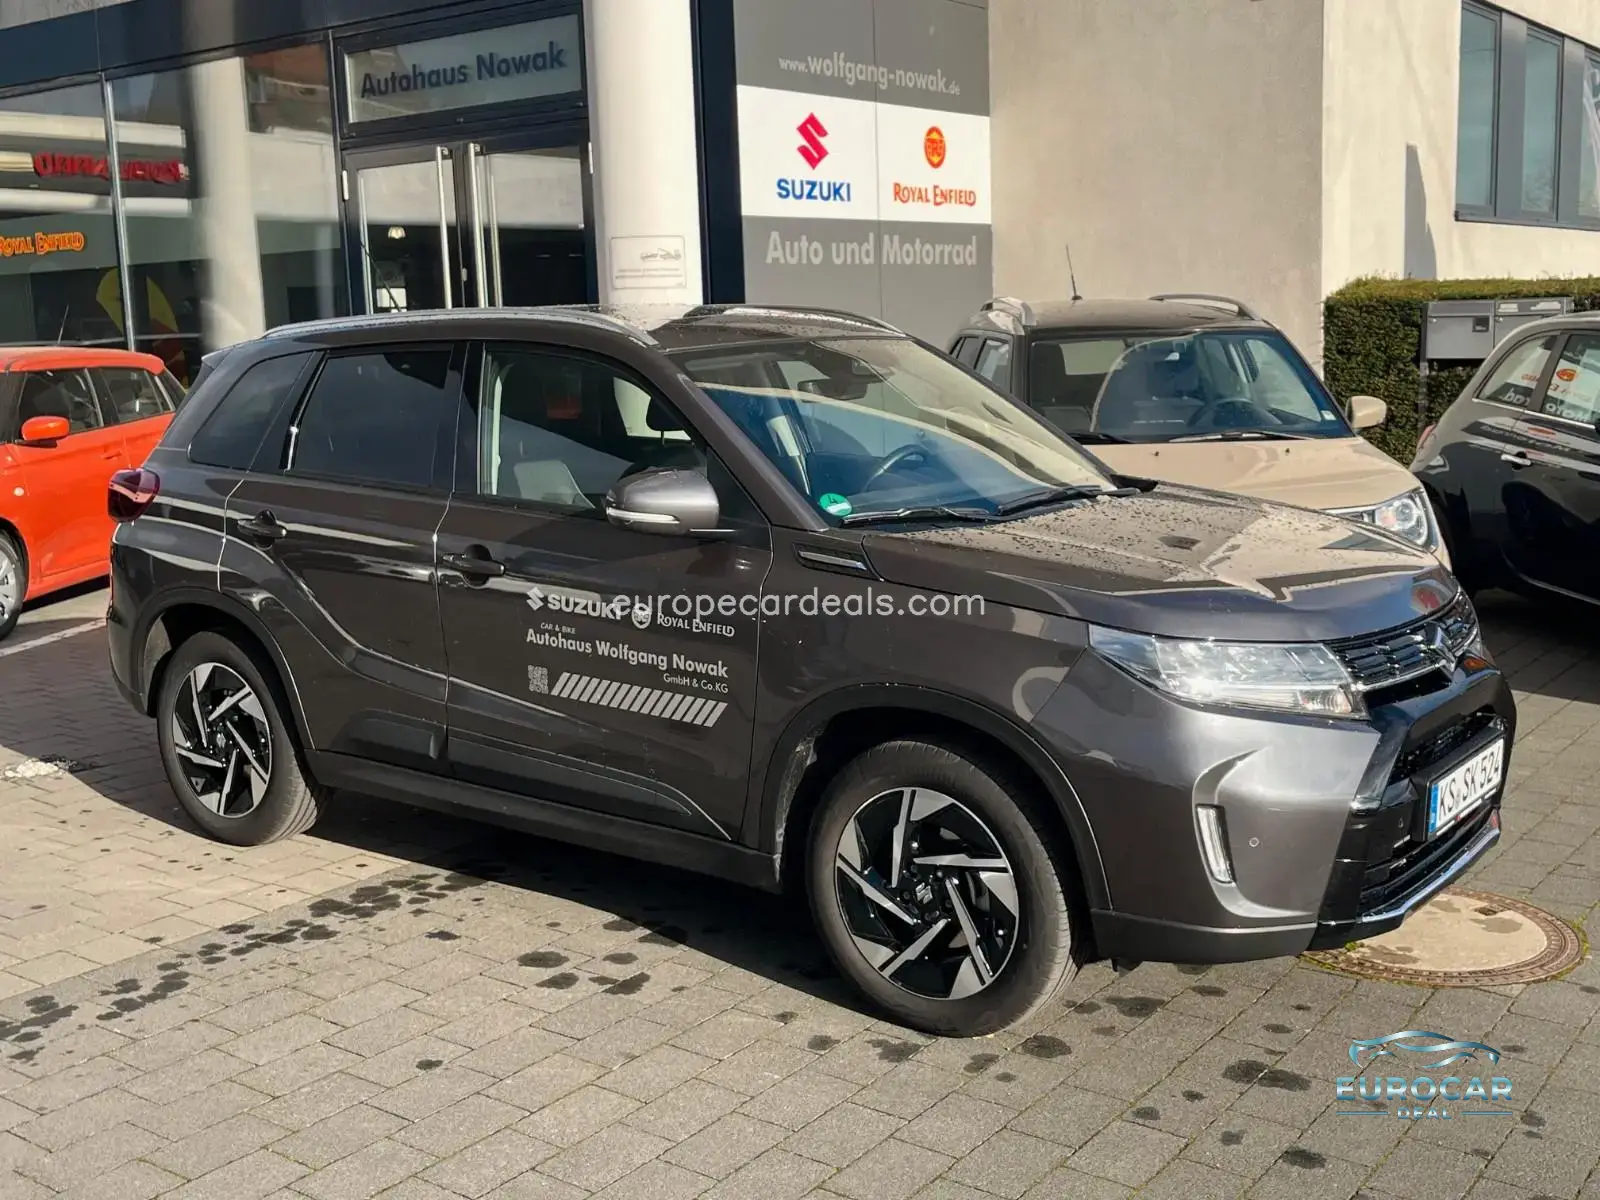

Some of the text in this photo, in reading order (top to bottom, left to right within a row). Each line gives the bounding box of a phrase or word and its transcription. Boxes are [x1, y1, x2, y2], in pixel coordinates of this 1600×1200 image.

[361, 41, 567, 98] Autohaus Nowak
[778, 51, 961, 96] www.wolfgang-nowak.de
[776, 178, 852, 202] SUZUKI
[765, 231, 977, 266] Auto und Motorrad
[547, 593, 622, 620] SUZUKI
[540, 622, 554, 632] CAR
[561, 625, 577, 634] BIKE
[526, 628, 729, 678] Autohaus Wolfgang Nowak
[663, 673, 729, 694] GmbH & Co.KG
[1440, 745, 1501, 816] KS SK 524
